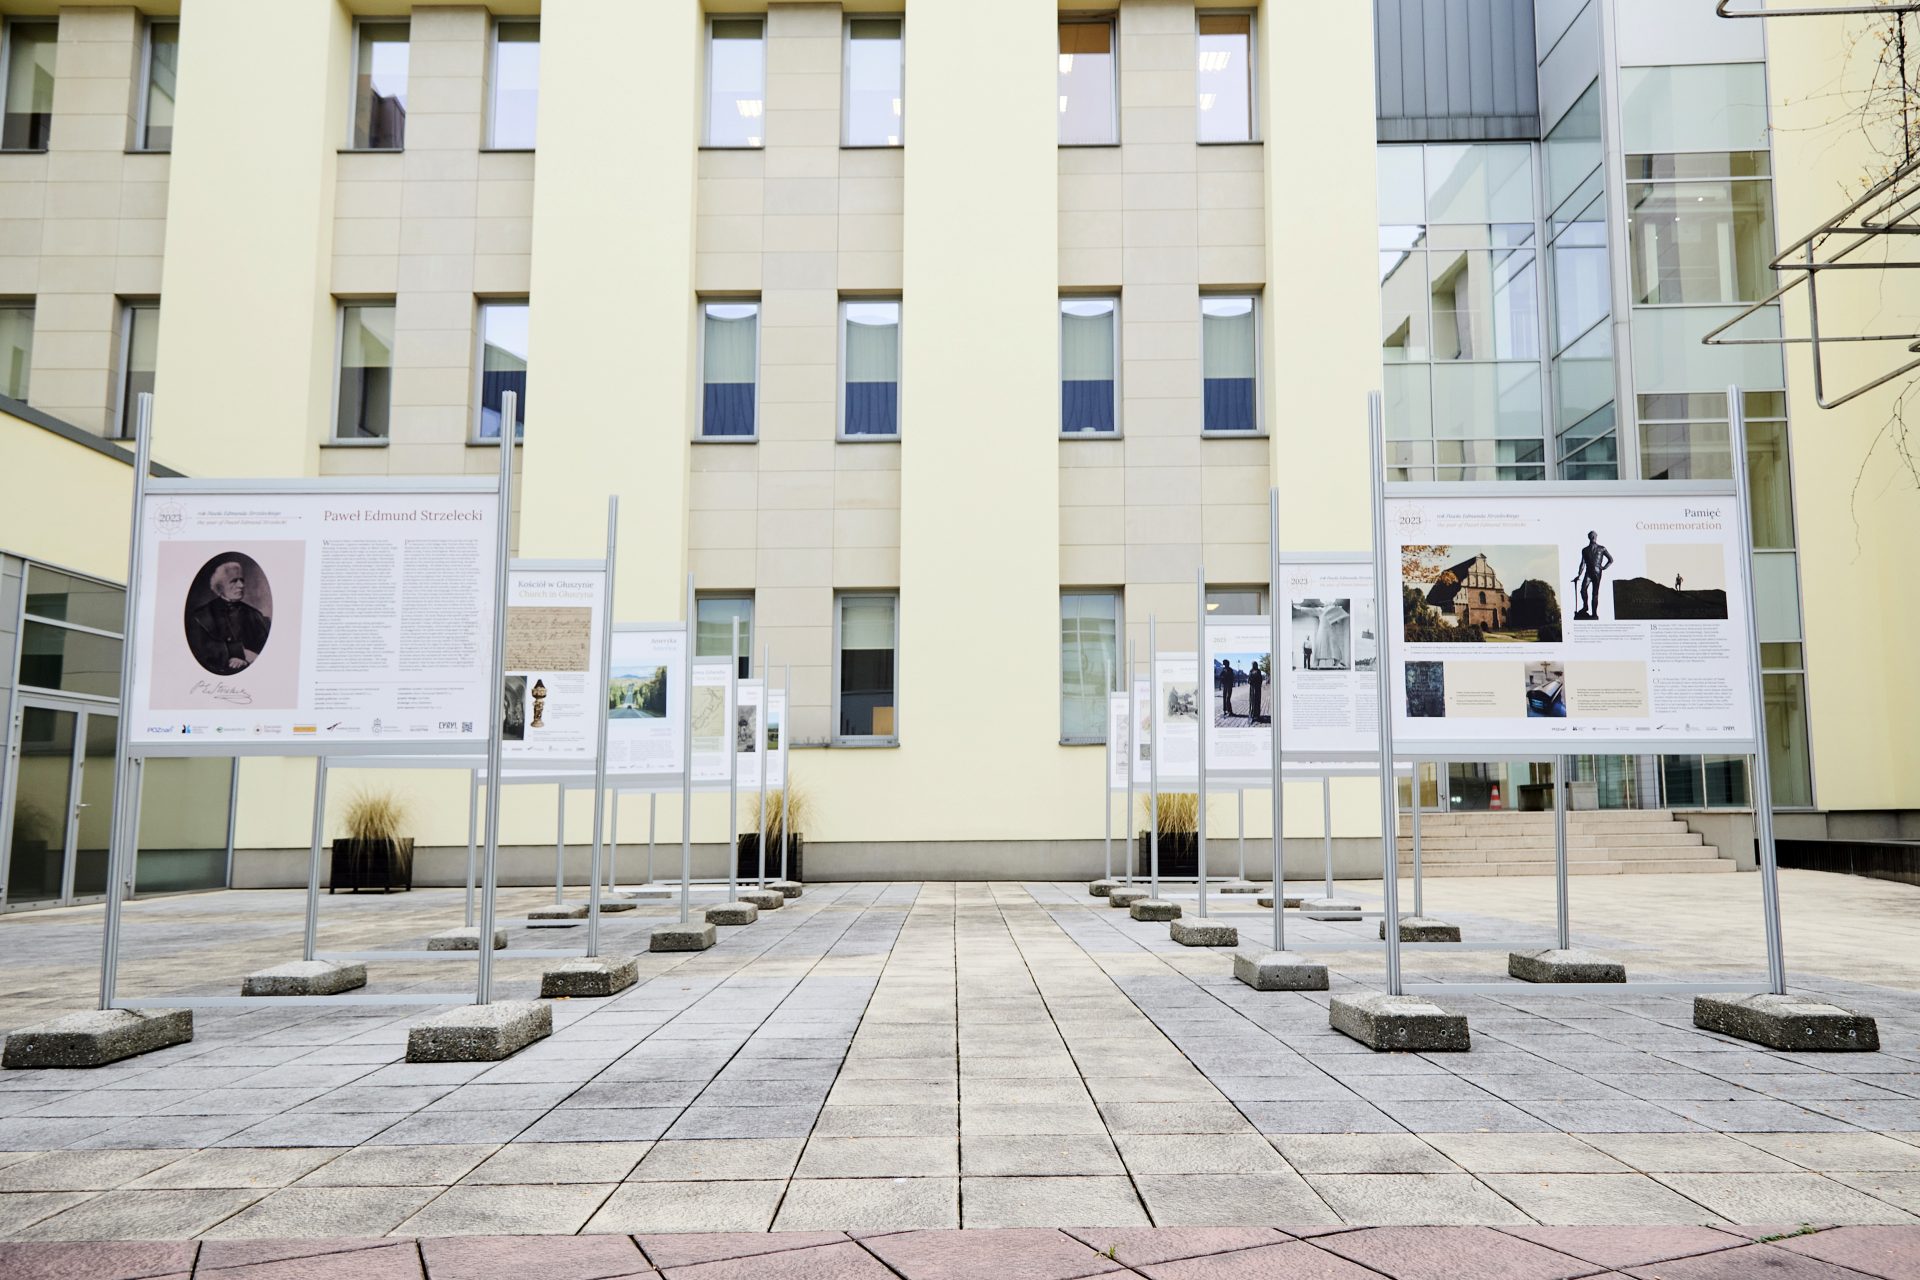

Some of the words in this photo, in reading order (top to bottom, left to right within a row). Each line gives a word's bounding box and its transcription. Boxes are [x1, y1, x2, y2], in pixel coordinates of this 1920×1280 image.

[159, 514, 182, 522] 2023
[324, 509, 361, 521] Paweł
[364, 509, 417, 521] Edmund
[420, 509, 483, 521] Strzelecki
[1684, 508, 1721, 519] Pamięć
[1399, 516, 1421, 525] 2023
[1635, 521, 1722, 531] Commemoration
[518, 580, 546, 588] Kościół
